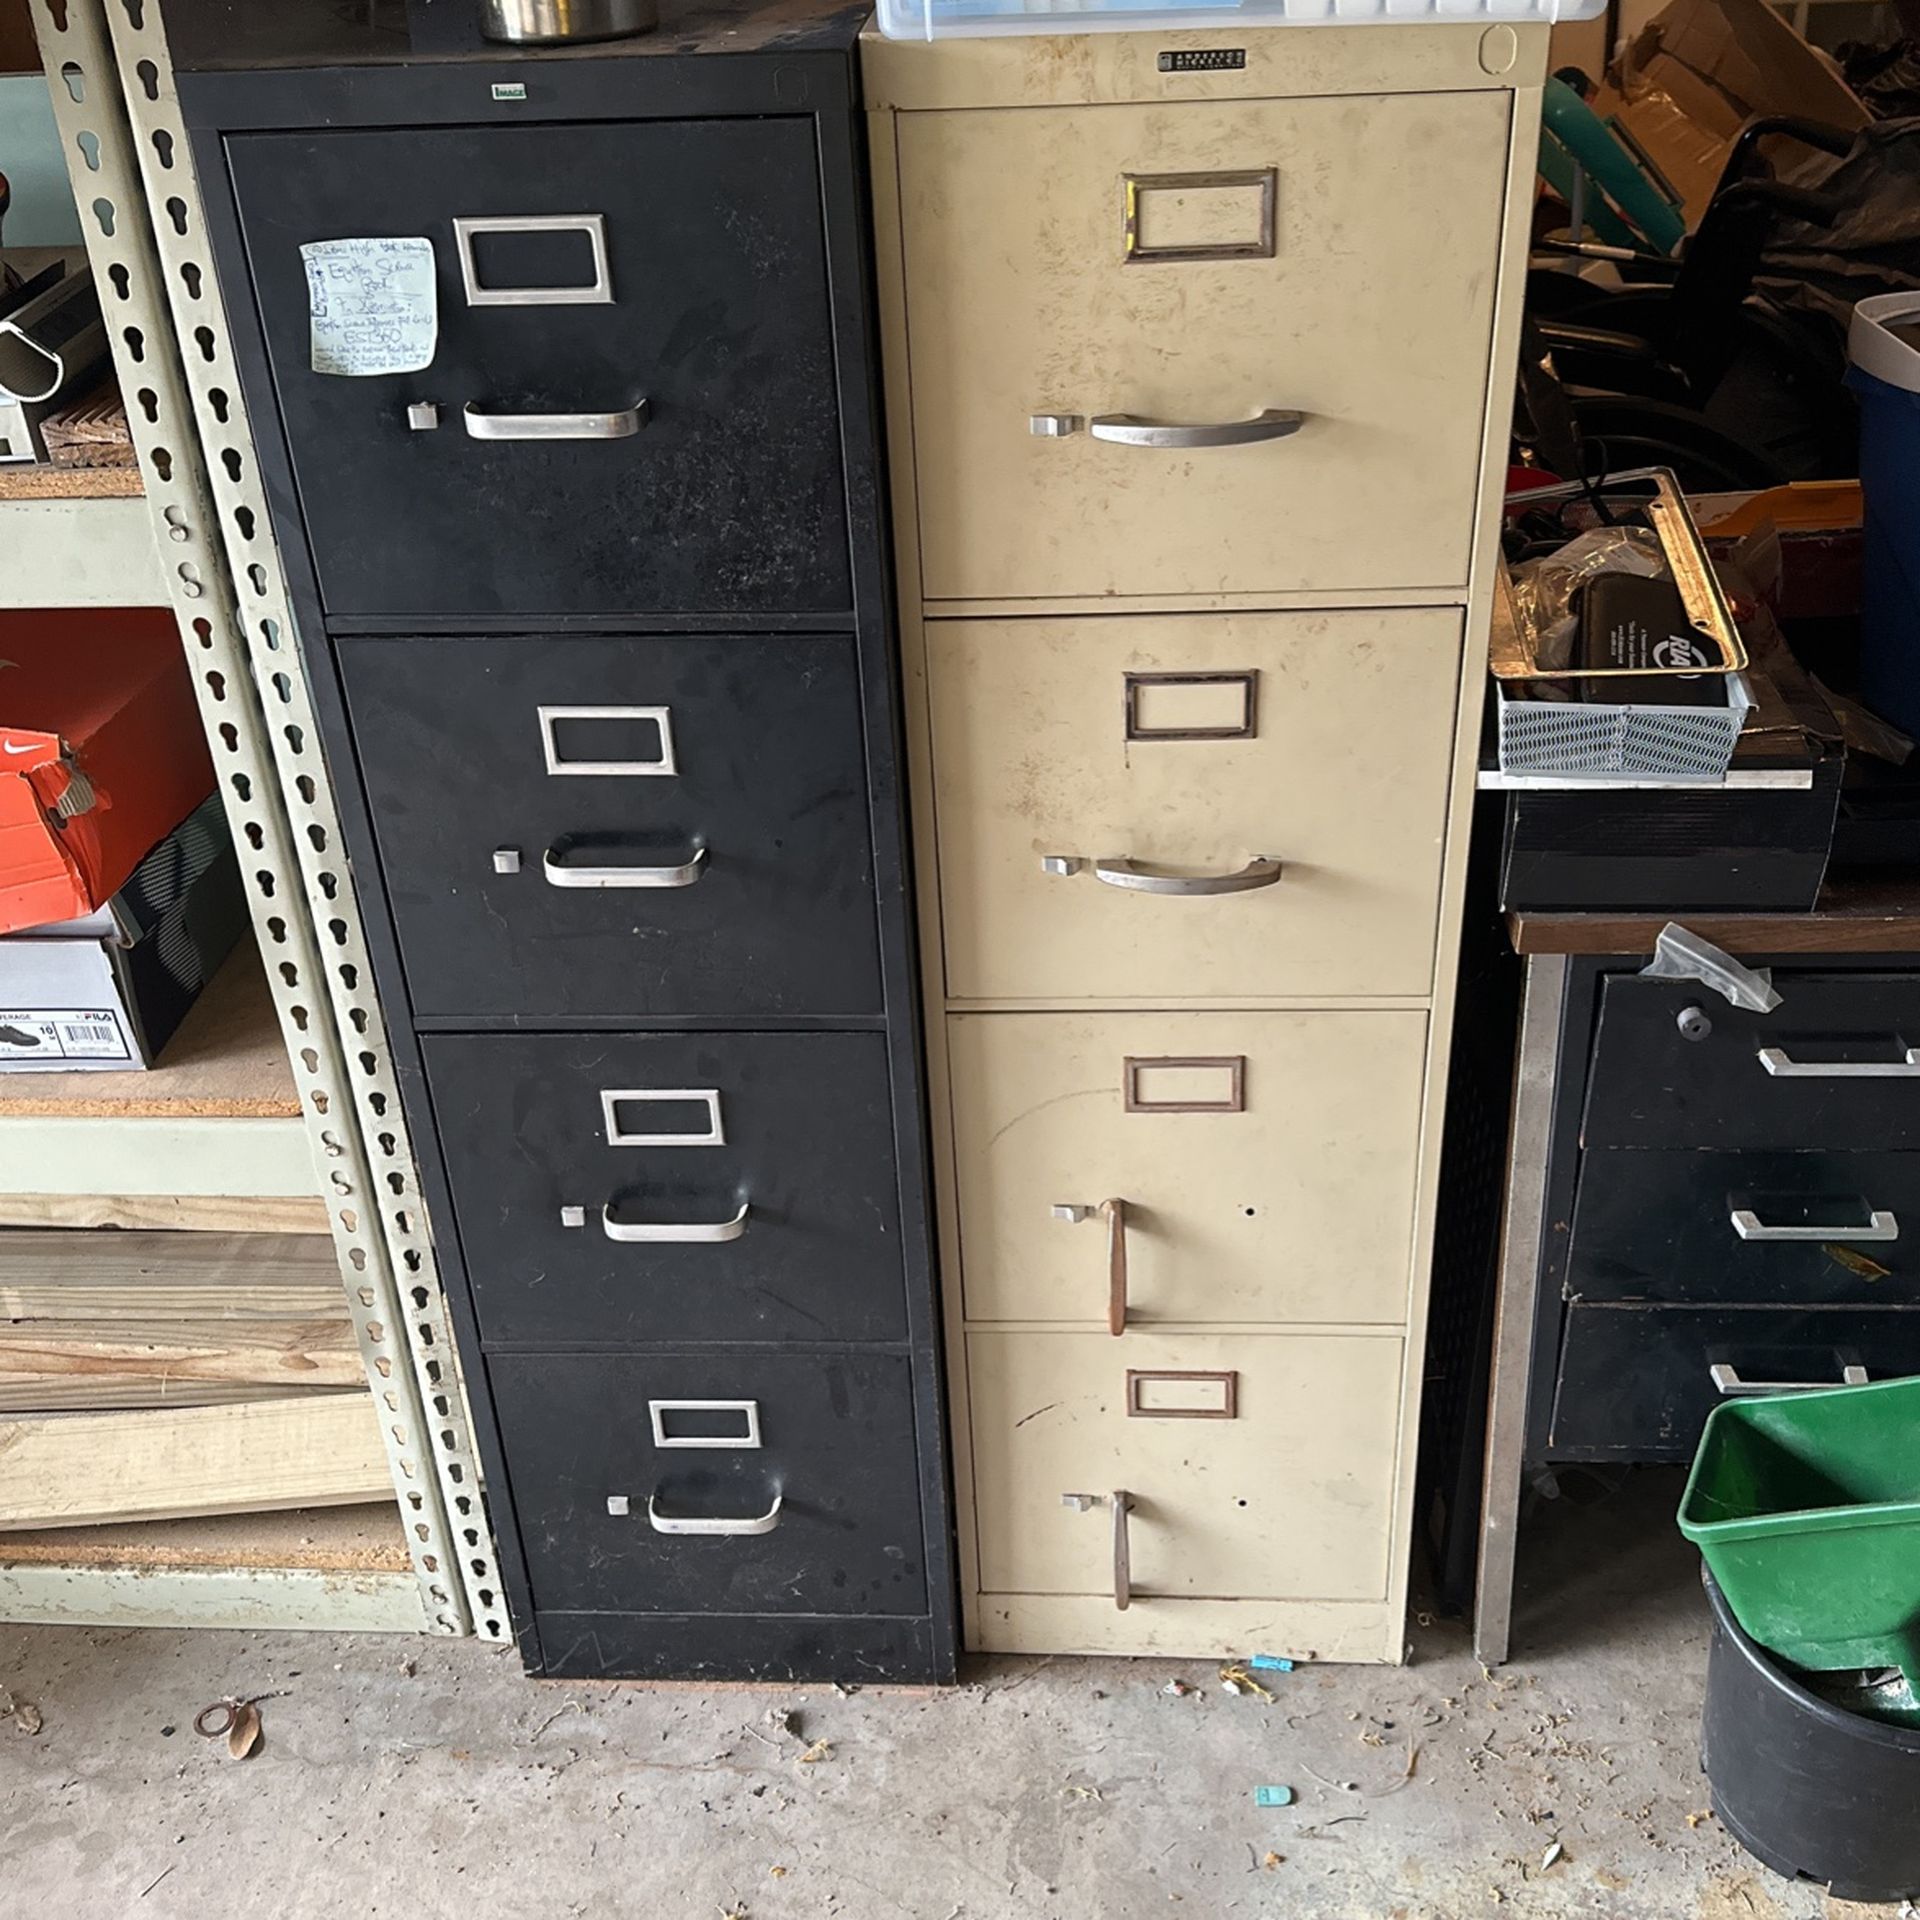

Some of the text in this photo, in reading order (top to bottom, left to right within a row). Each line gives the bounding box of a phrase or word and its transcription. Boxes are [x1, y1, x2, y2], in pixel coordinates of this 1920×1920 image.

[1669, 634, 1692, 666] RIA
[84, 1013, 112, 1021] FILA
[40, 1026, 53, 1035] 10
